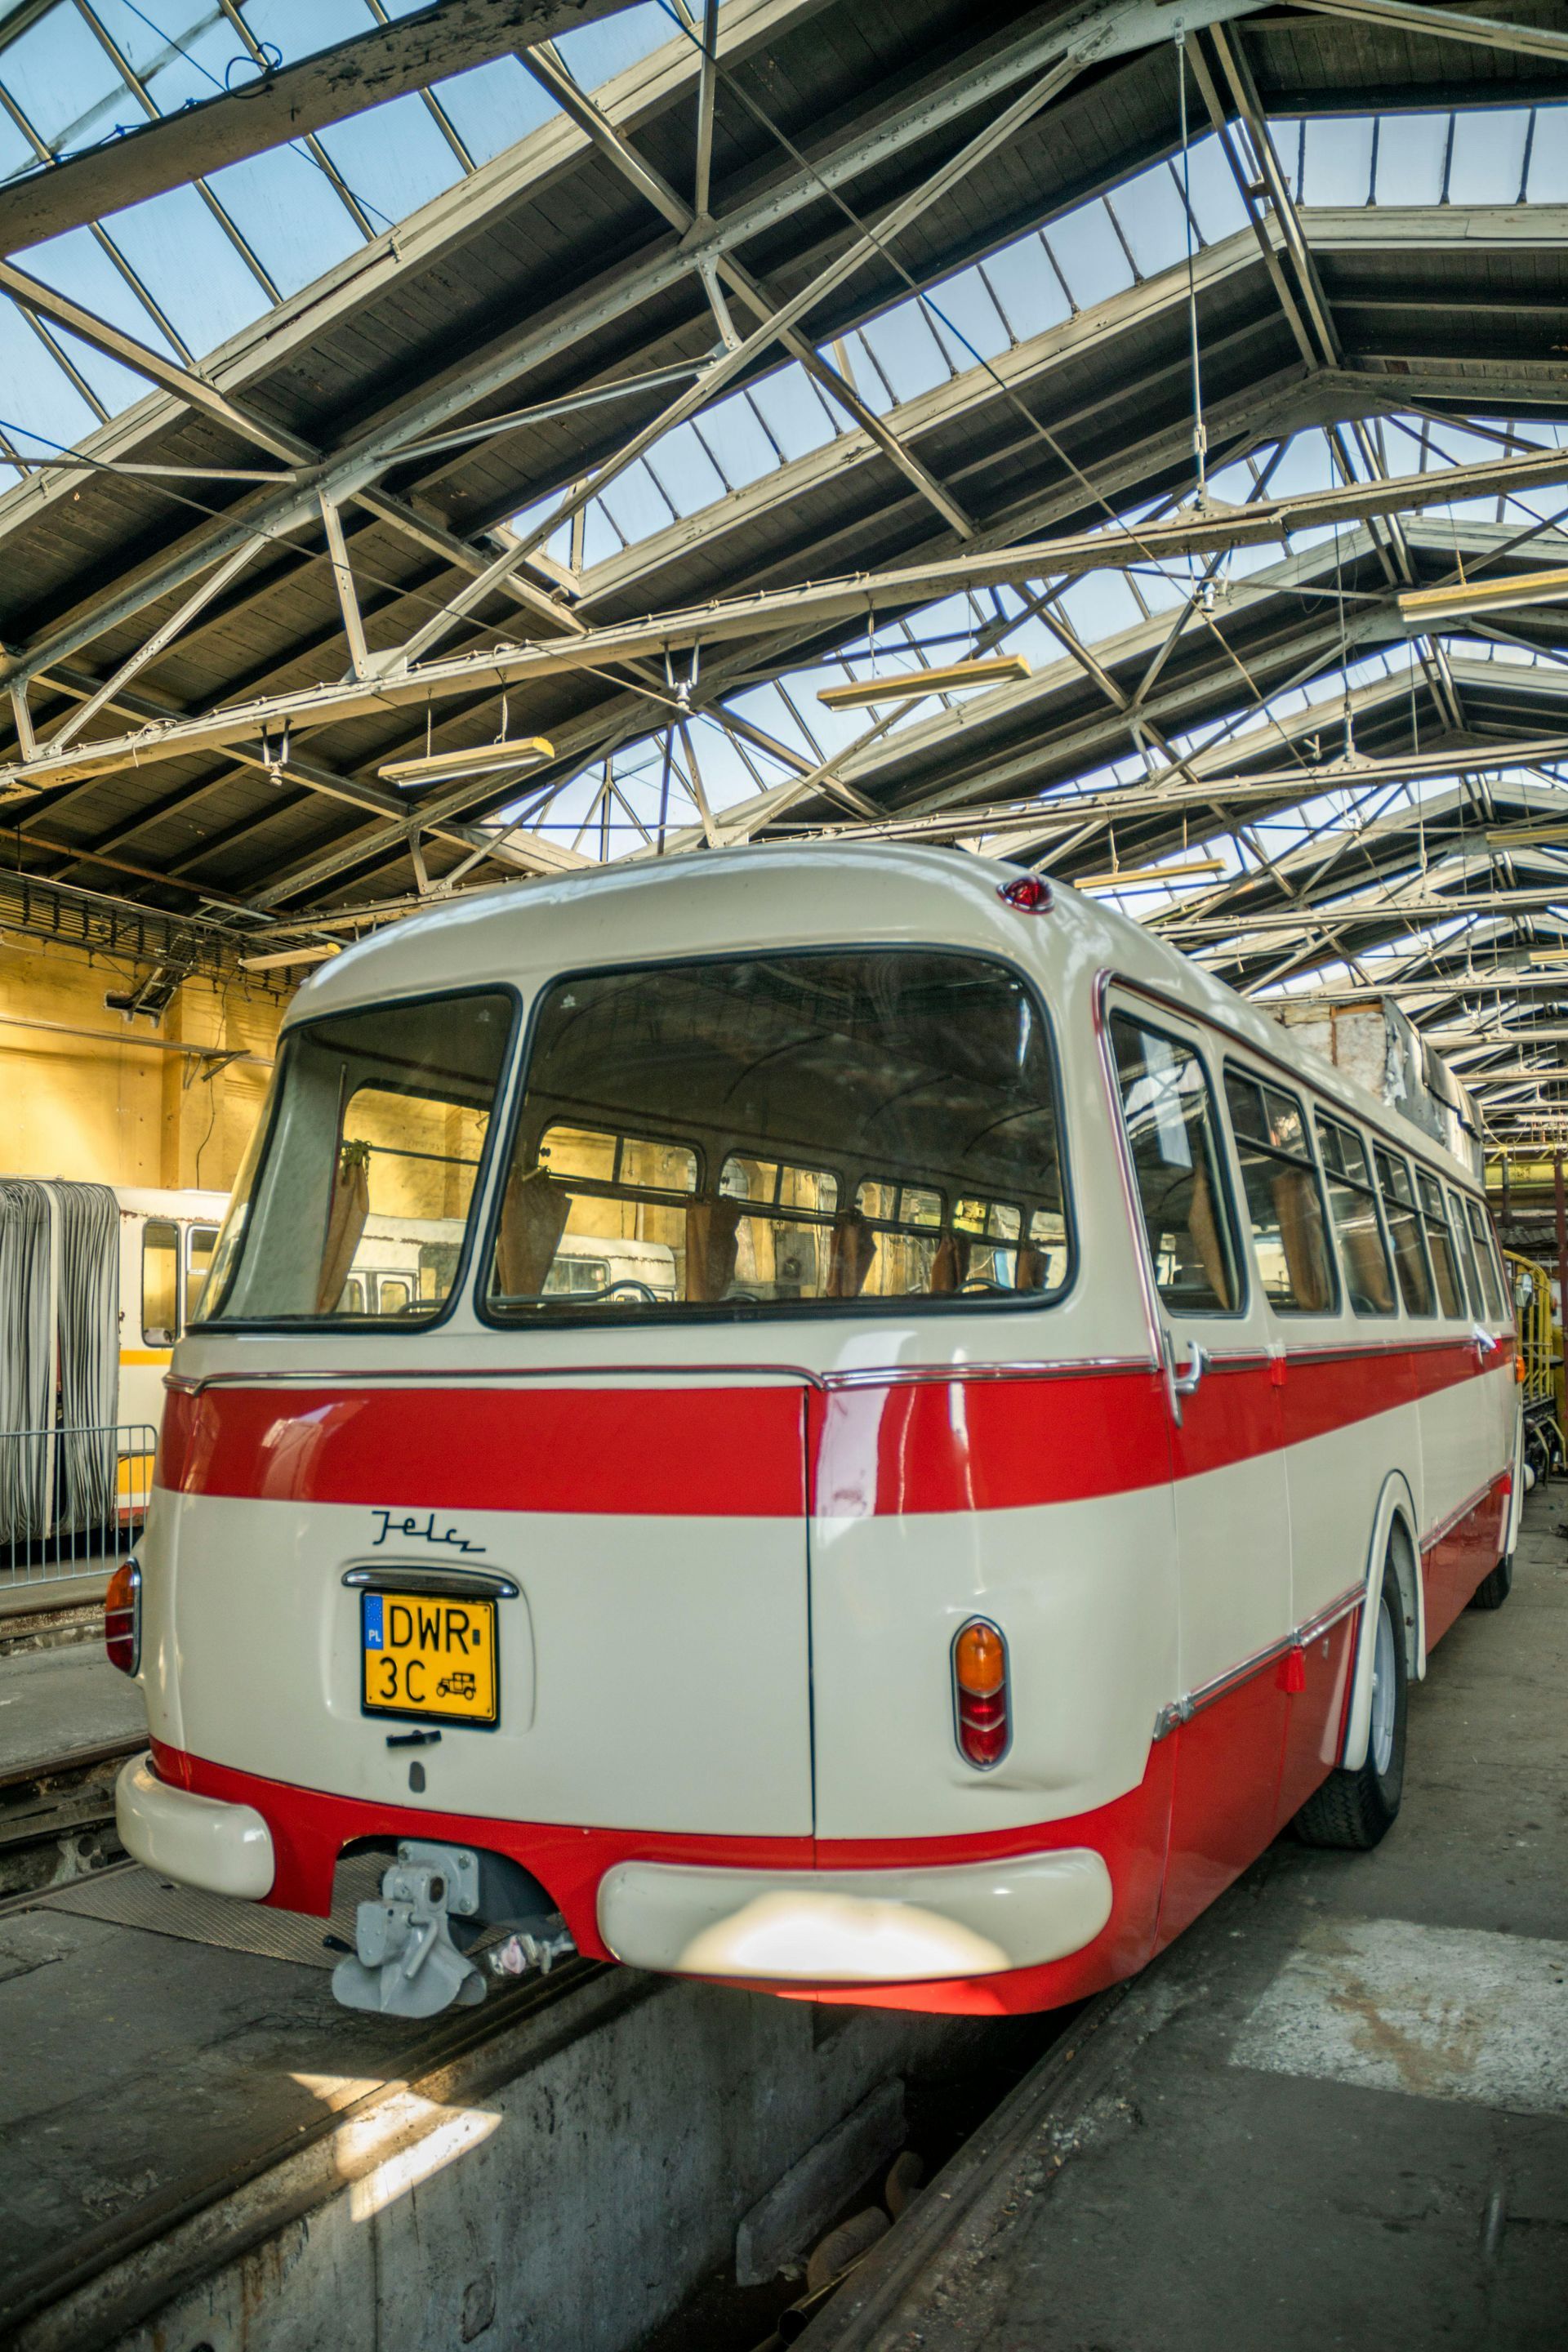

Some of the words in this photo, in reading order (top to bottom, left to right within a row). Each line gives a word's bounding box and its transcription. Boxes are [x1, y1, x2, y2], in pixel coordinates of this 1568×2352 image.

[372, 1511, 486, 1552] Jelcz
[368, 1629, 381, 1642] PL
[390, 1605, 470, 1655] DWR
[380, 1657, 425, 1703] 3C
